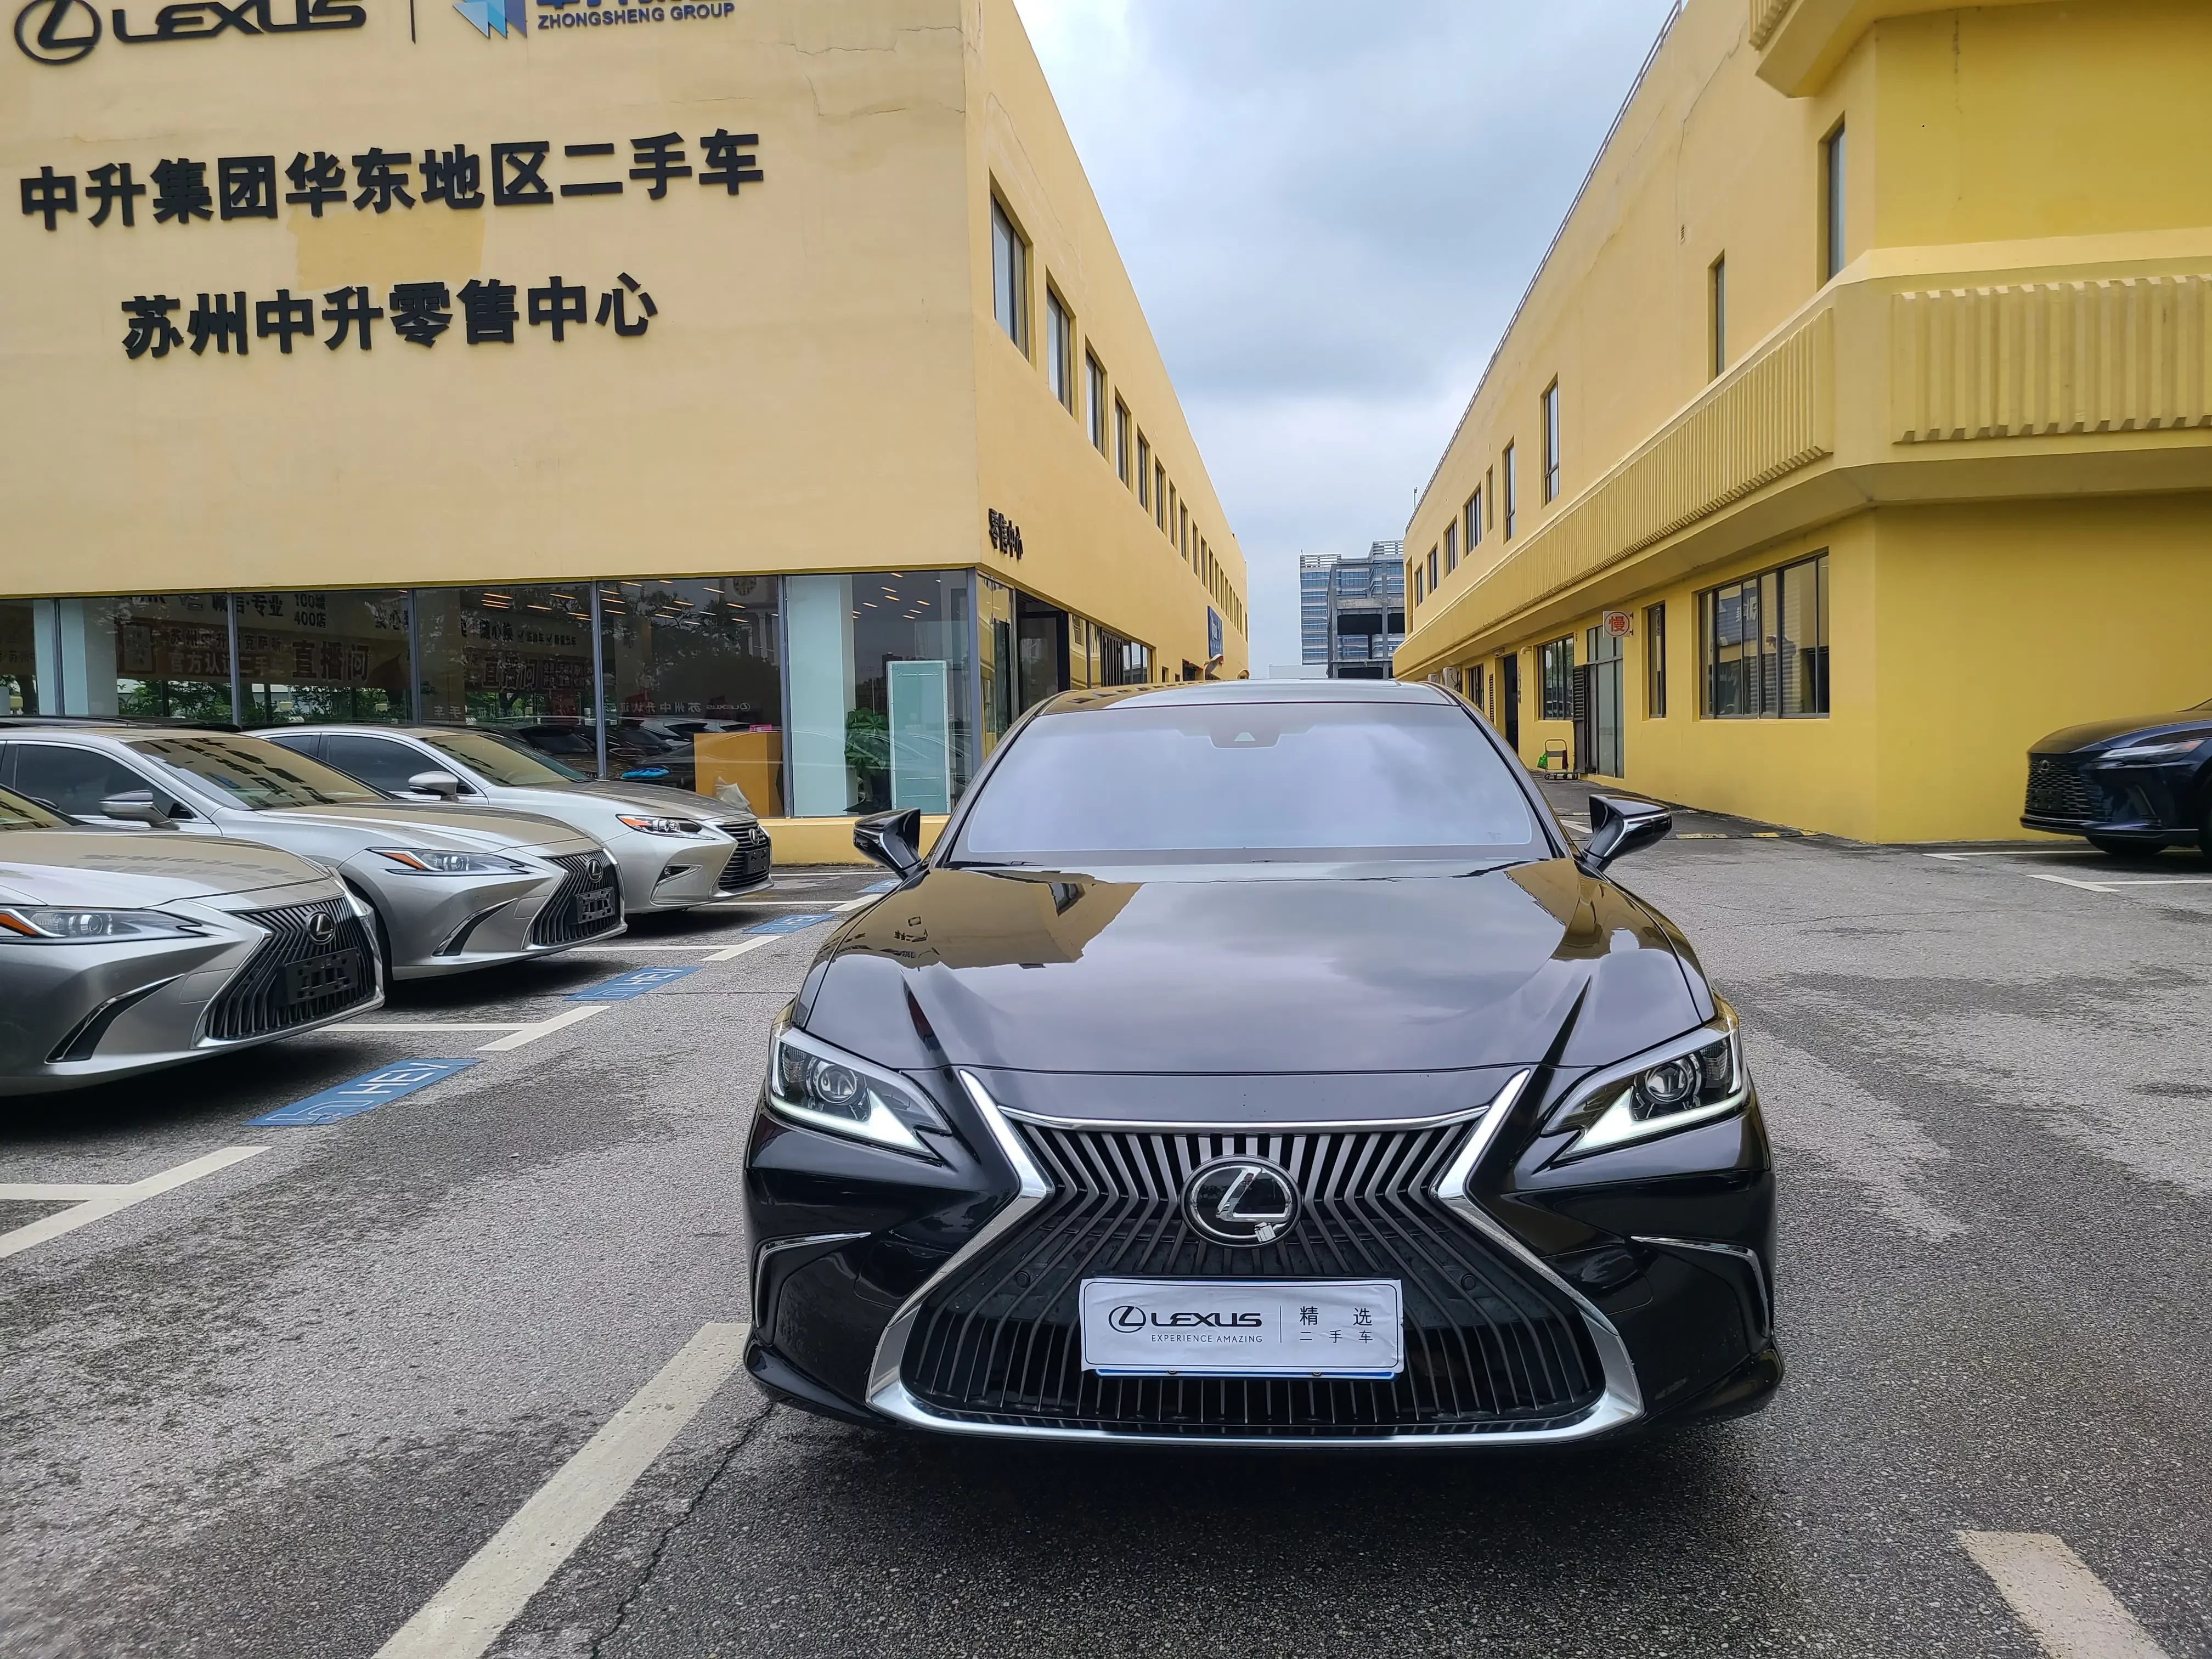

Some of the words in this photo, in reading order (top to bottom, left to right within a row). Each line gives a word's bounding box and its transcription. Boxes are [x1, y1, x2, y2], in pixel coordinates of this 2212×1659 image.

[112, 0, 366, 42] LEXUS
[538, 8, 664, 29] ZHONGSHENG
[670, 2, 735, 21] GROUP
[20, 128, 764, 230] 中升集团华东地区二手车
[122, 272, 658, 359] 苏州中升零售中心
[989, 508, 1023, 561] 零售中心
[1609, 616, 1625, 632] 慢
[291, 640, 370, 682] 直播间
[774, 915, 822, 926] HEV
[614, 968, 684, 985] HEV
[337, 1062, 449, 1094] HEV
[1151, 1312, 1262, 1327] LEXUS
[1300, 1306, 1373, 1326] 精选
[1152, 1334, 1212, 1343] EXPERIENCE
[1216, 1335, 1263, 1344] AMAZING
[1300, 1330, 1373, 1344] 二手车
